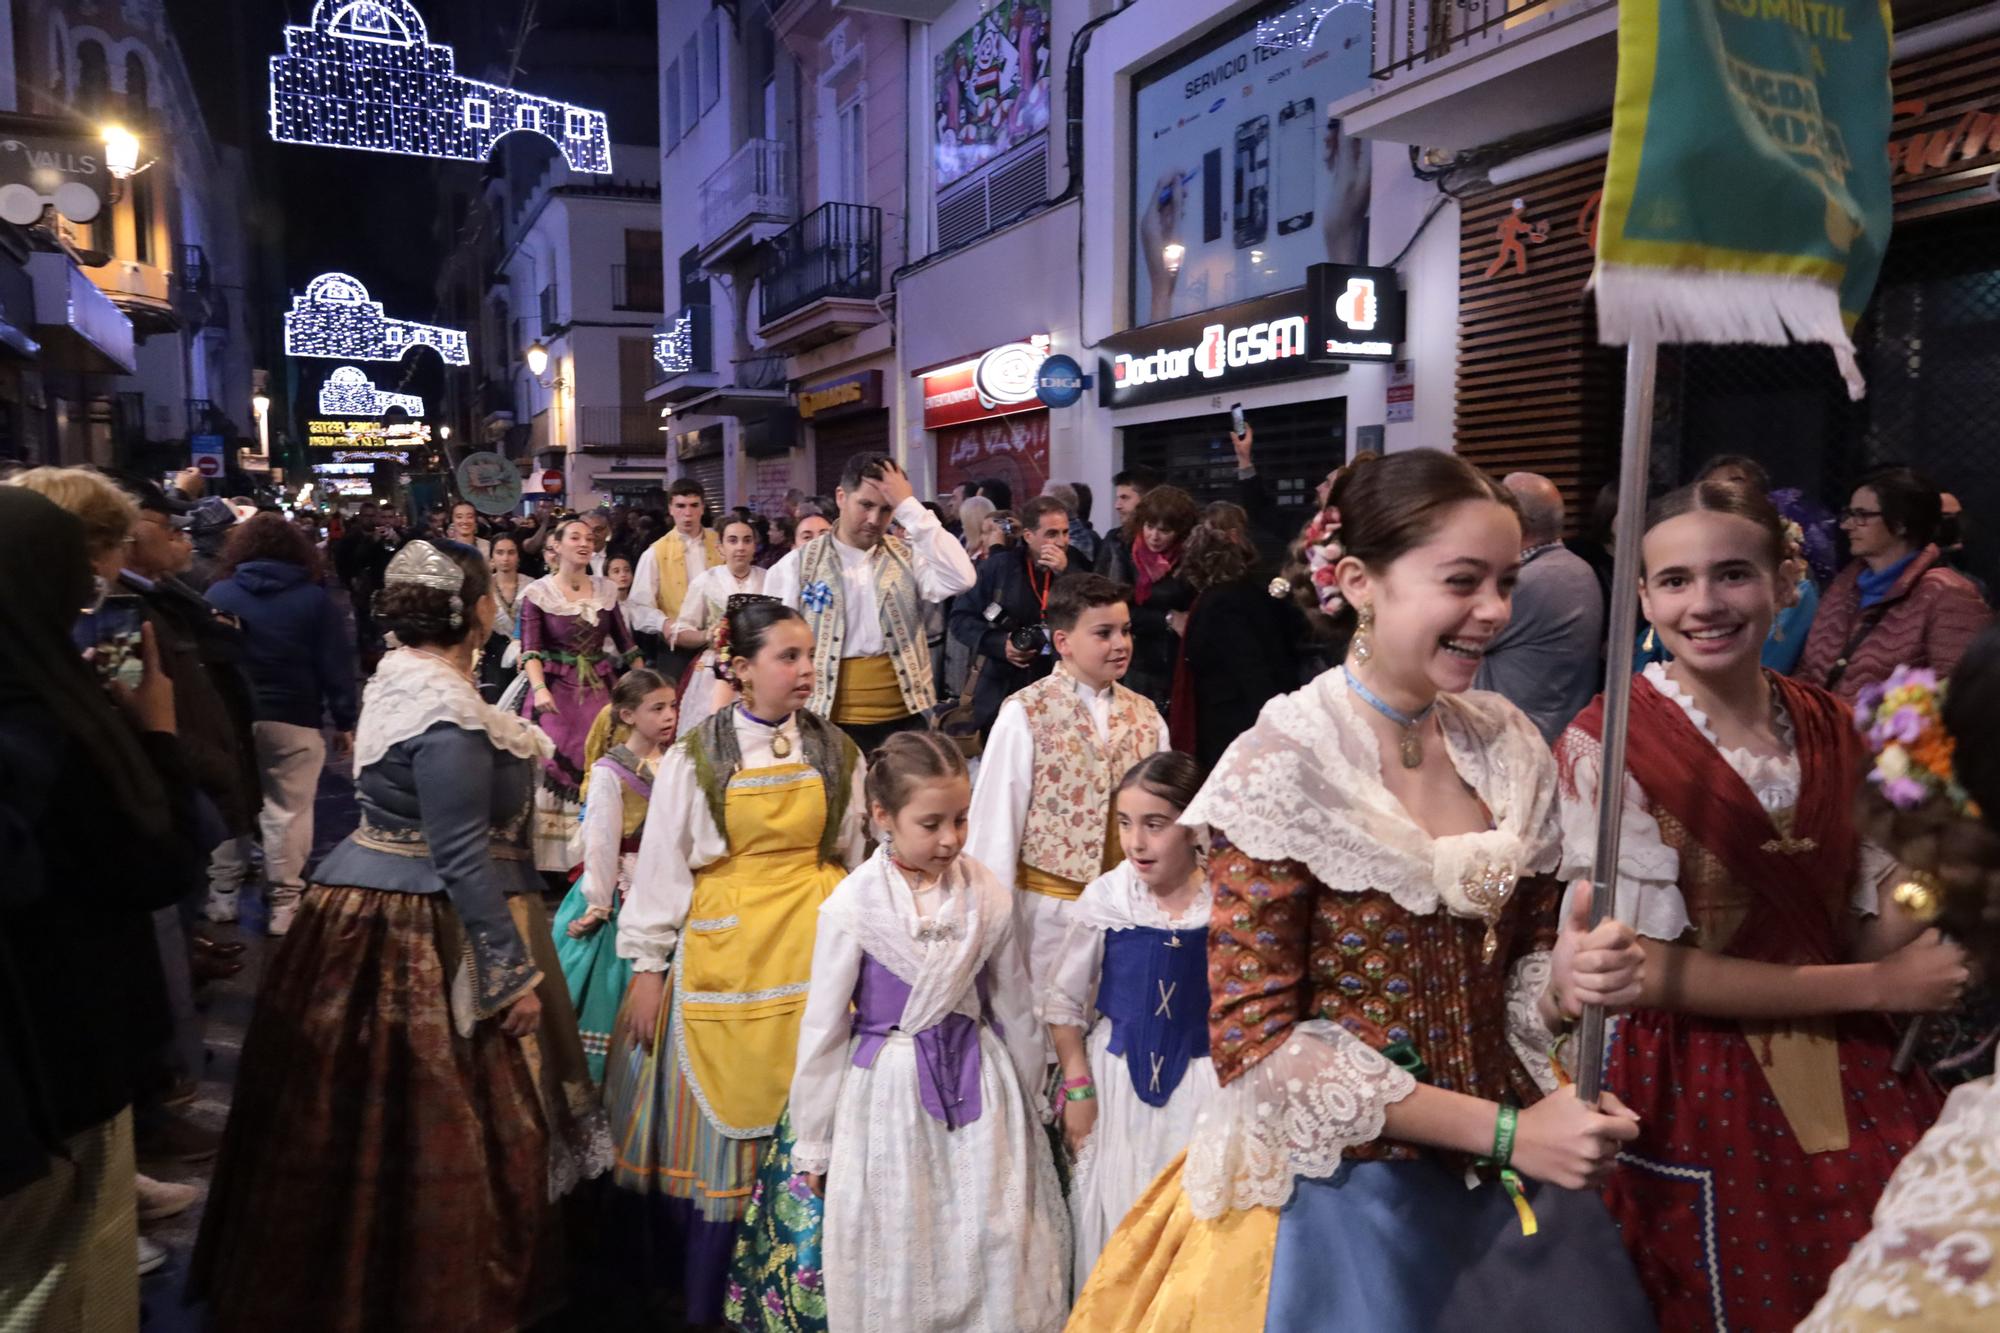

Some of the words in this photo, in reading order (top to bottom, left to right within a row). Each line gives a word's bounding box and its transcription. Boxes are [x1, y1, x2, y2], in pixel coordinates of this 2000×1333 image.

[1185, 54, 1247, 99] SERVICIO
[25, 149, 97, 174] VALLS
[1040, 377, 1081, 389] DIGI
[1115, 348, 1195, 389] Doctor
